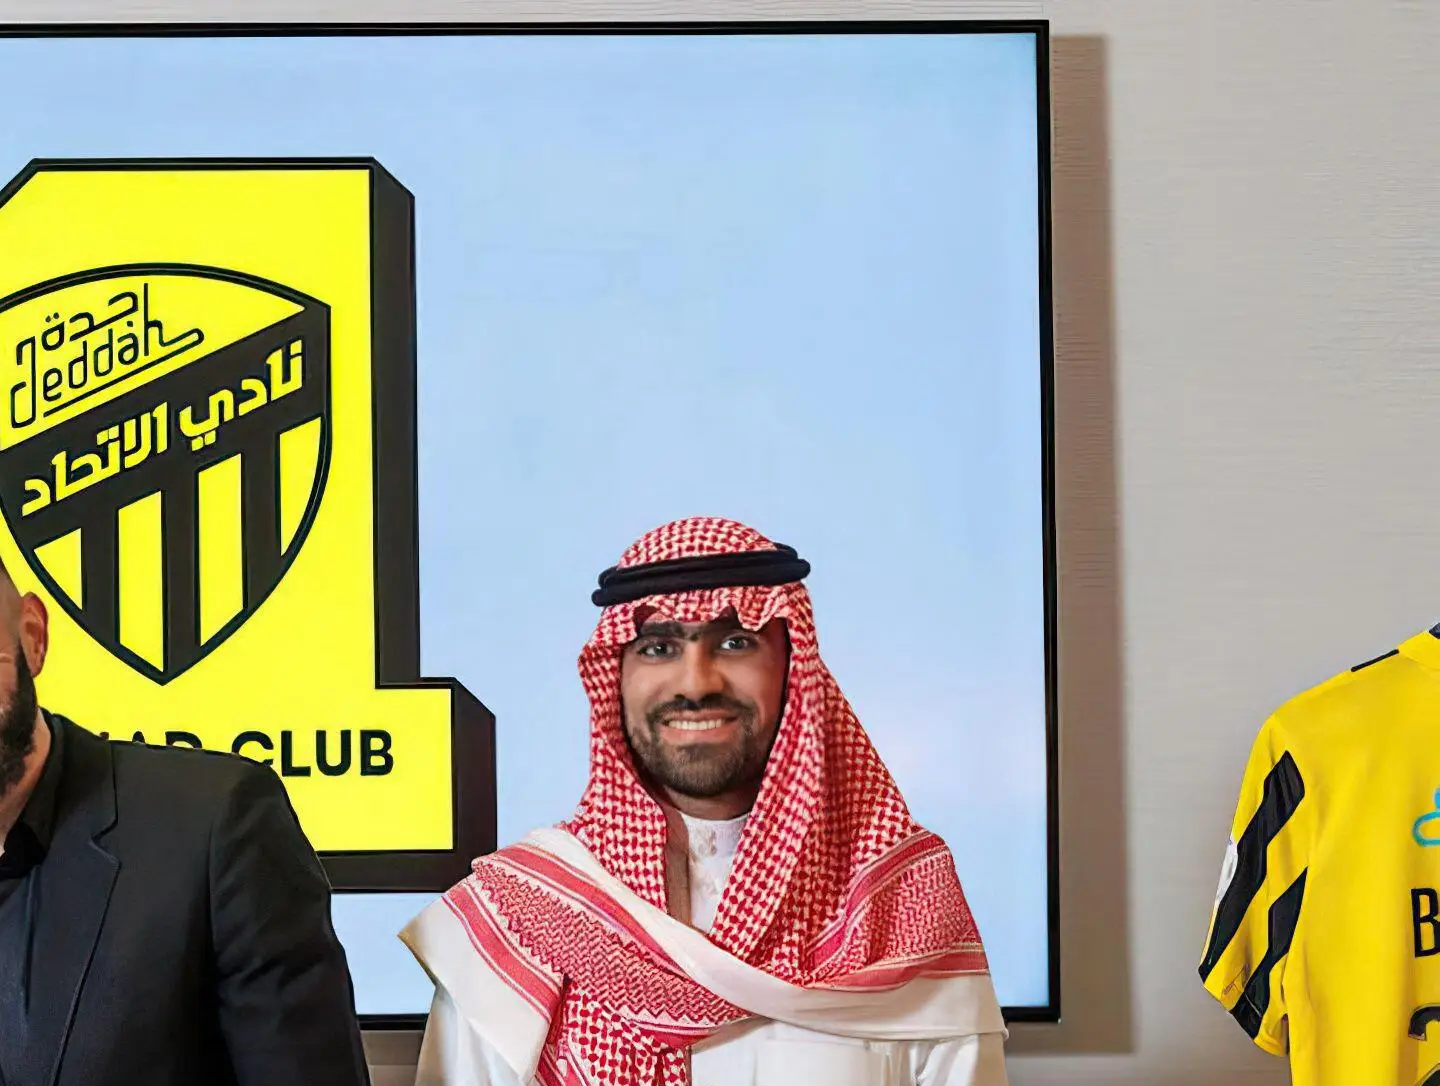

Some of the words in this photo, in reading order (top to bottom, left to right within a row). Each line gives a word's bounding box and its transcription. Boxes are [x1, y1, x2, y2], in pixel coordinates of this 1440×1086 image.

[180, 339, 303, 451] نادي
[22, 401, 168, 518] الاتحاد
[231, 729, 393, 777] CLUB
